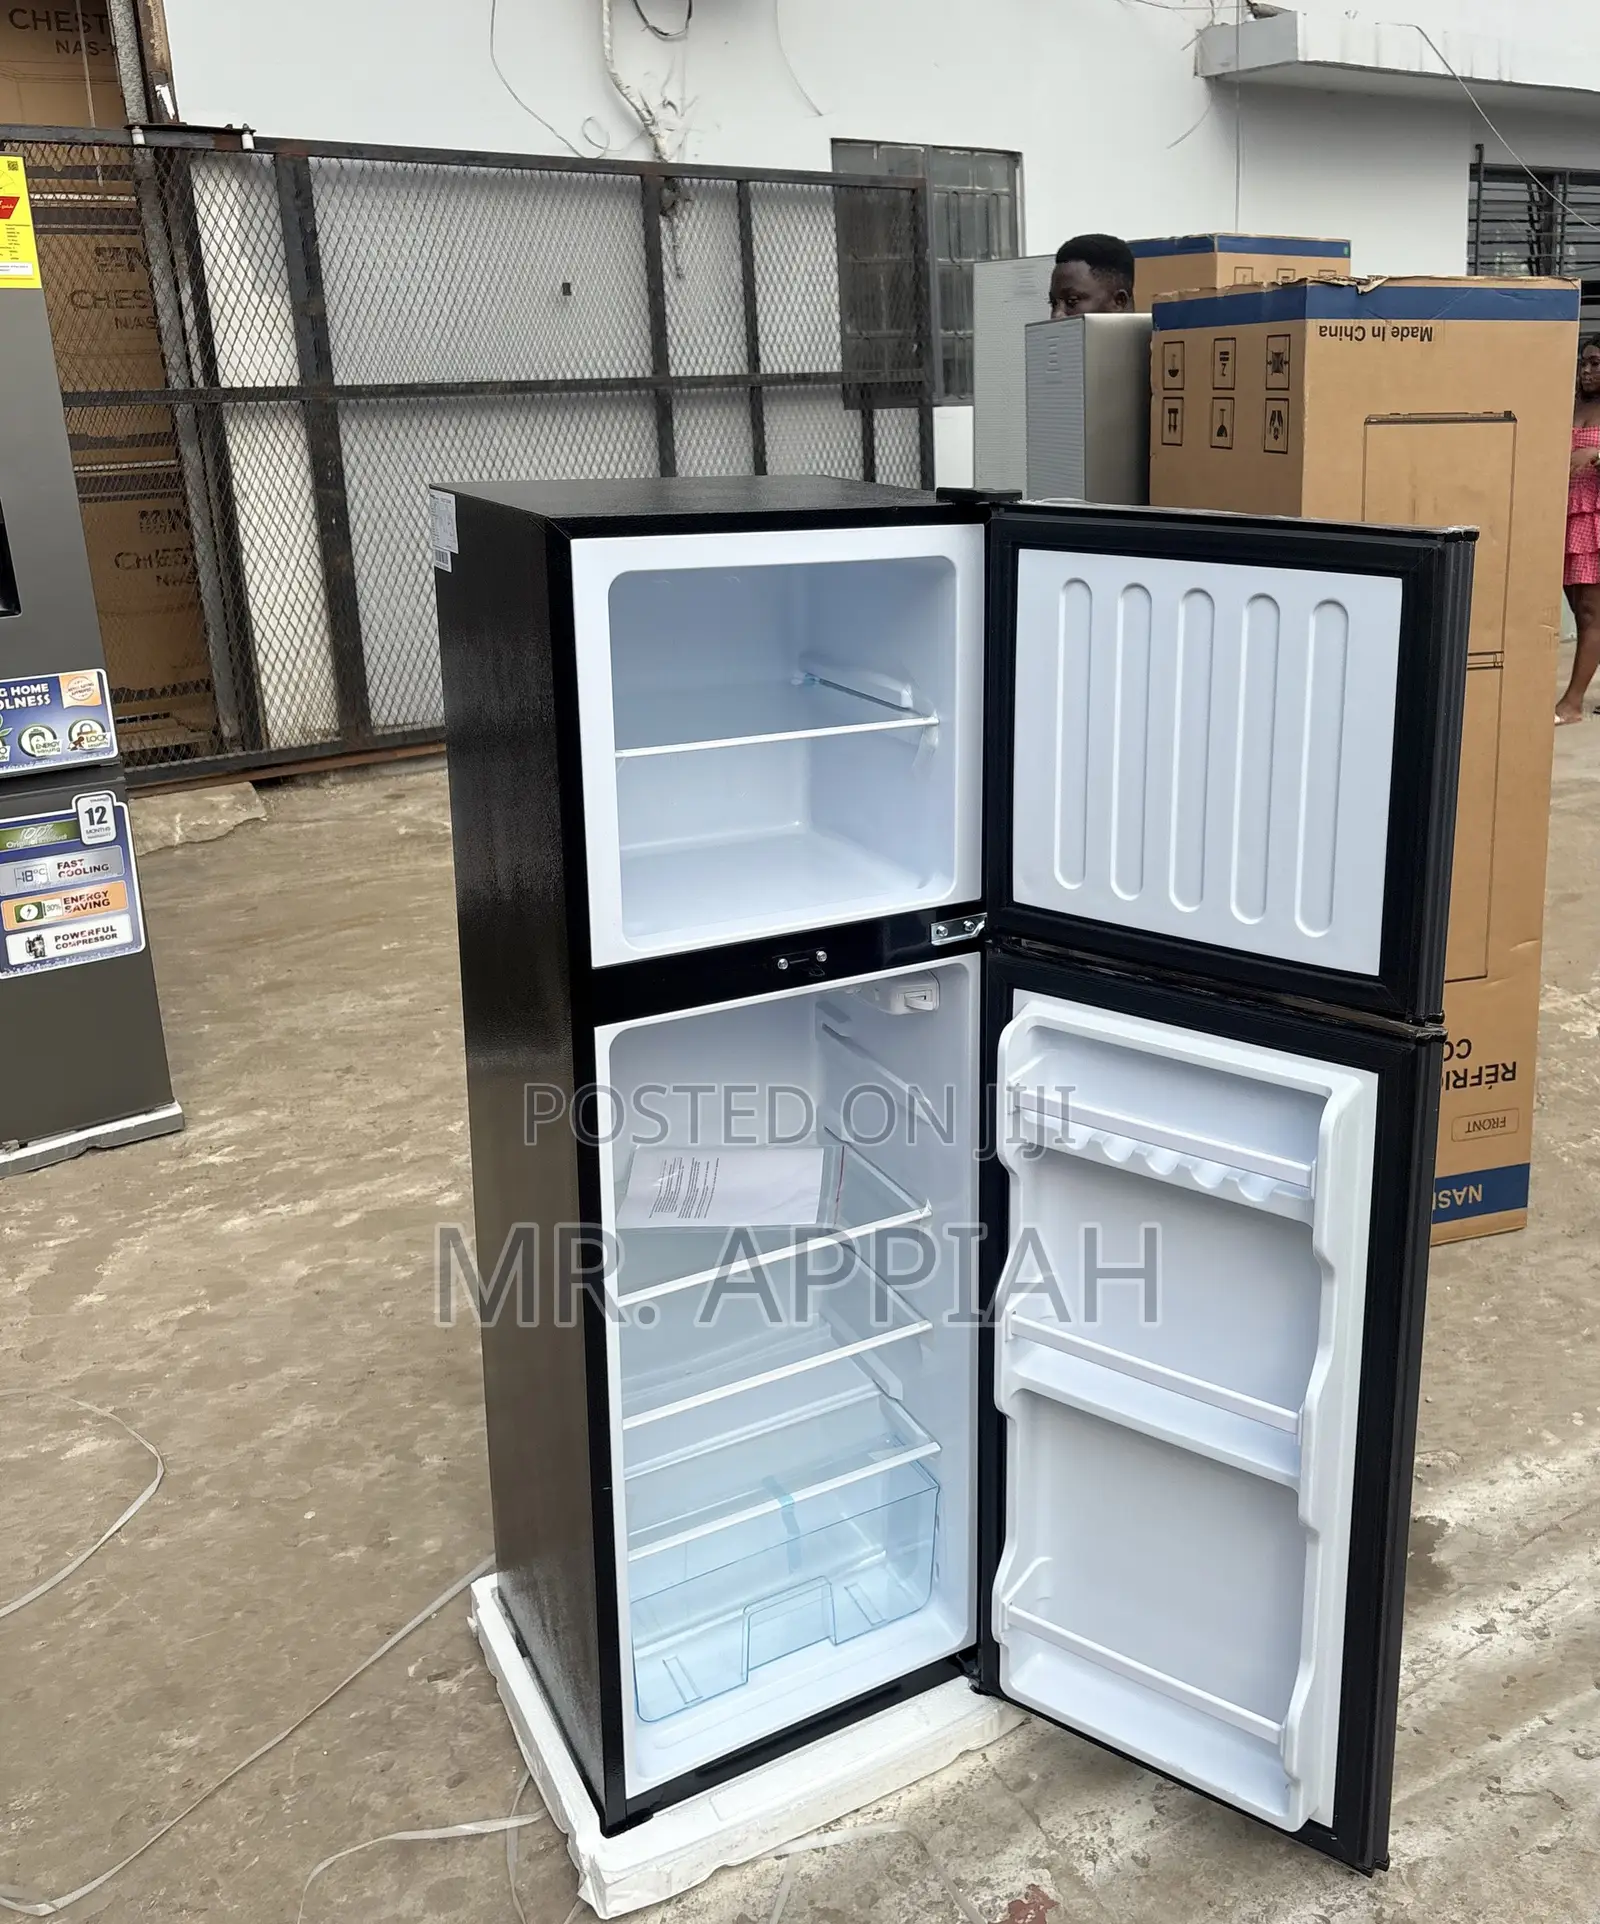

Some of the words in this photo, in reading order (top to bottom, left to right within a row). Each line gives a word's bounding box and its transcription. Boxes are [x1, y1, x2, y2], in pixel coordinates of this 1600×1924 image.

[9, 8, 108, 34] CHEST
[55, 39, 112, 57] NAS-
[1318, 325, 1366, 342] China
[1371, 326, 1386, 342] In
[1391, 326, 1433, 342] Made
[11, 683, 50, 697] HOME
[36, 740, 60, 750] ENERGY
[86, 734, 108, 744] LOCK
[84, 805, 108, 826] 12
[85, 826, 111, 835] MONTHS
[56, 858, 84, 870] FAST
[58, 863, 110, 879] COOLING
[63, 890, 109, 905] ENERGY
[64, 898, 111, 914] SAVING
[54, 925, 117, 942] POWERFUL
[55, 933, 118, 950] COMPRESSOR
[1442, 1061, 1517, 1090] RÉFRI
[1464, 1115, 1507, 1134] FRONT
